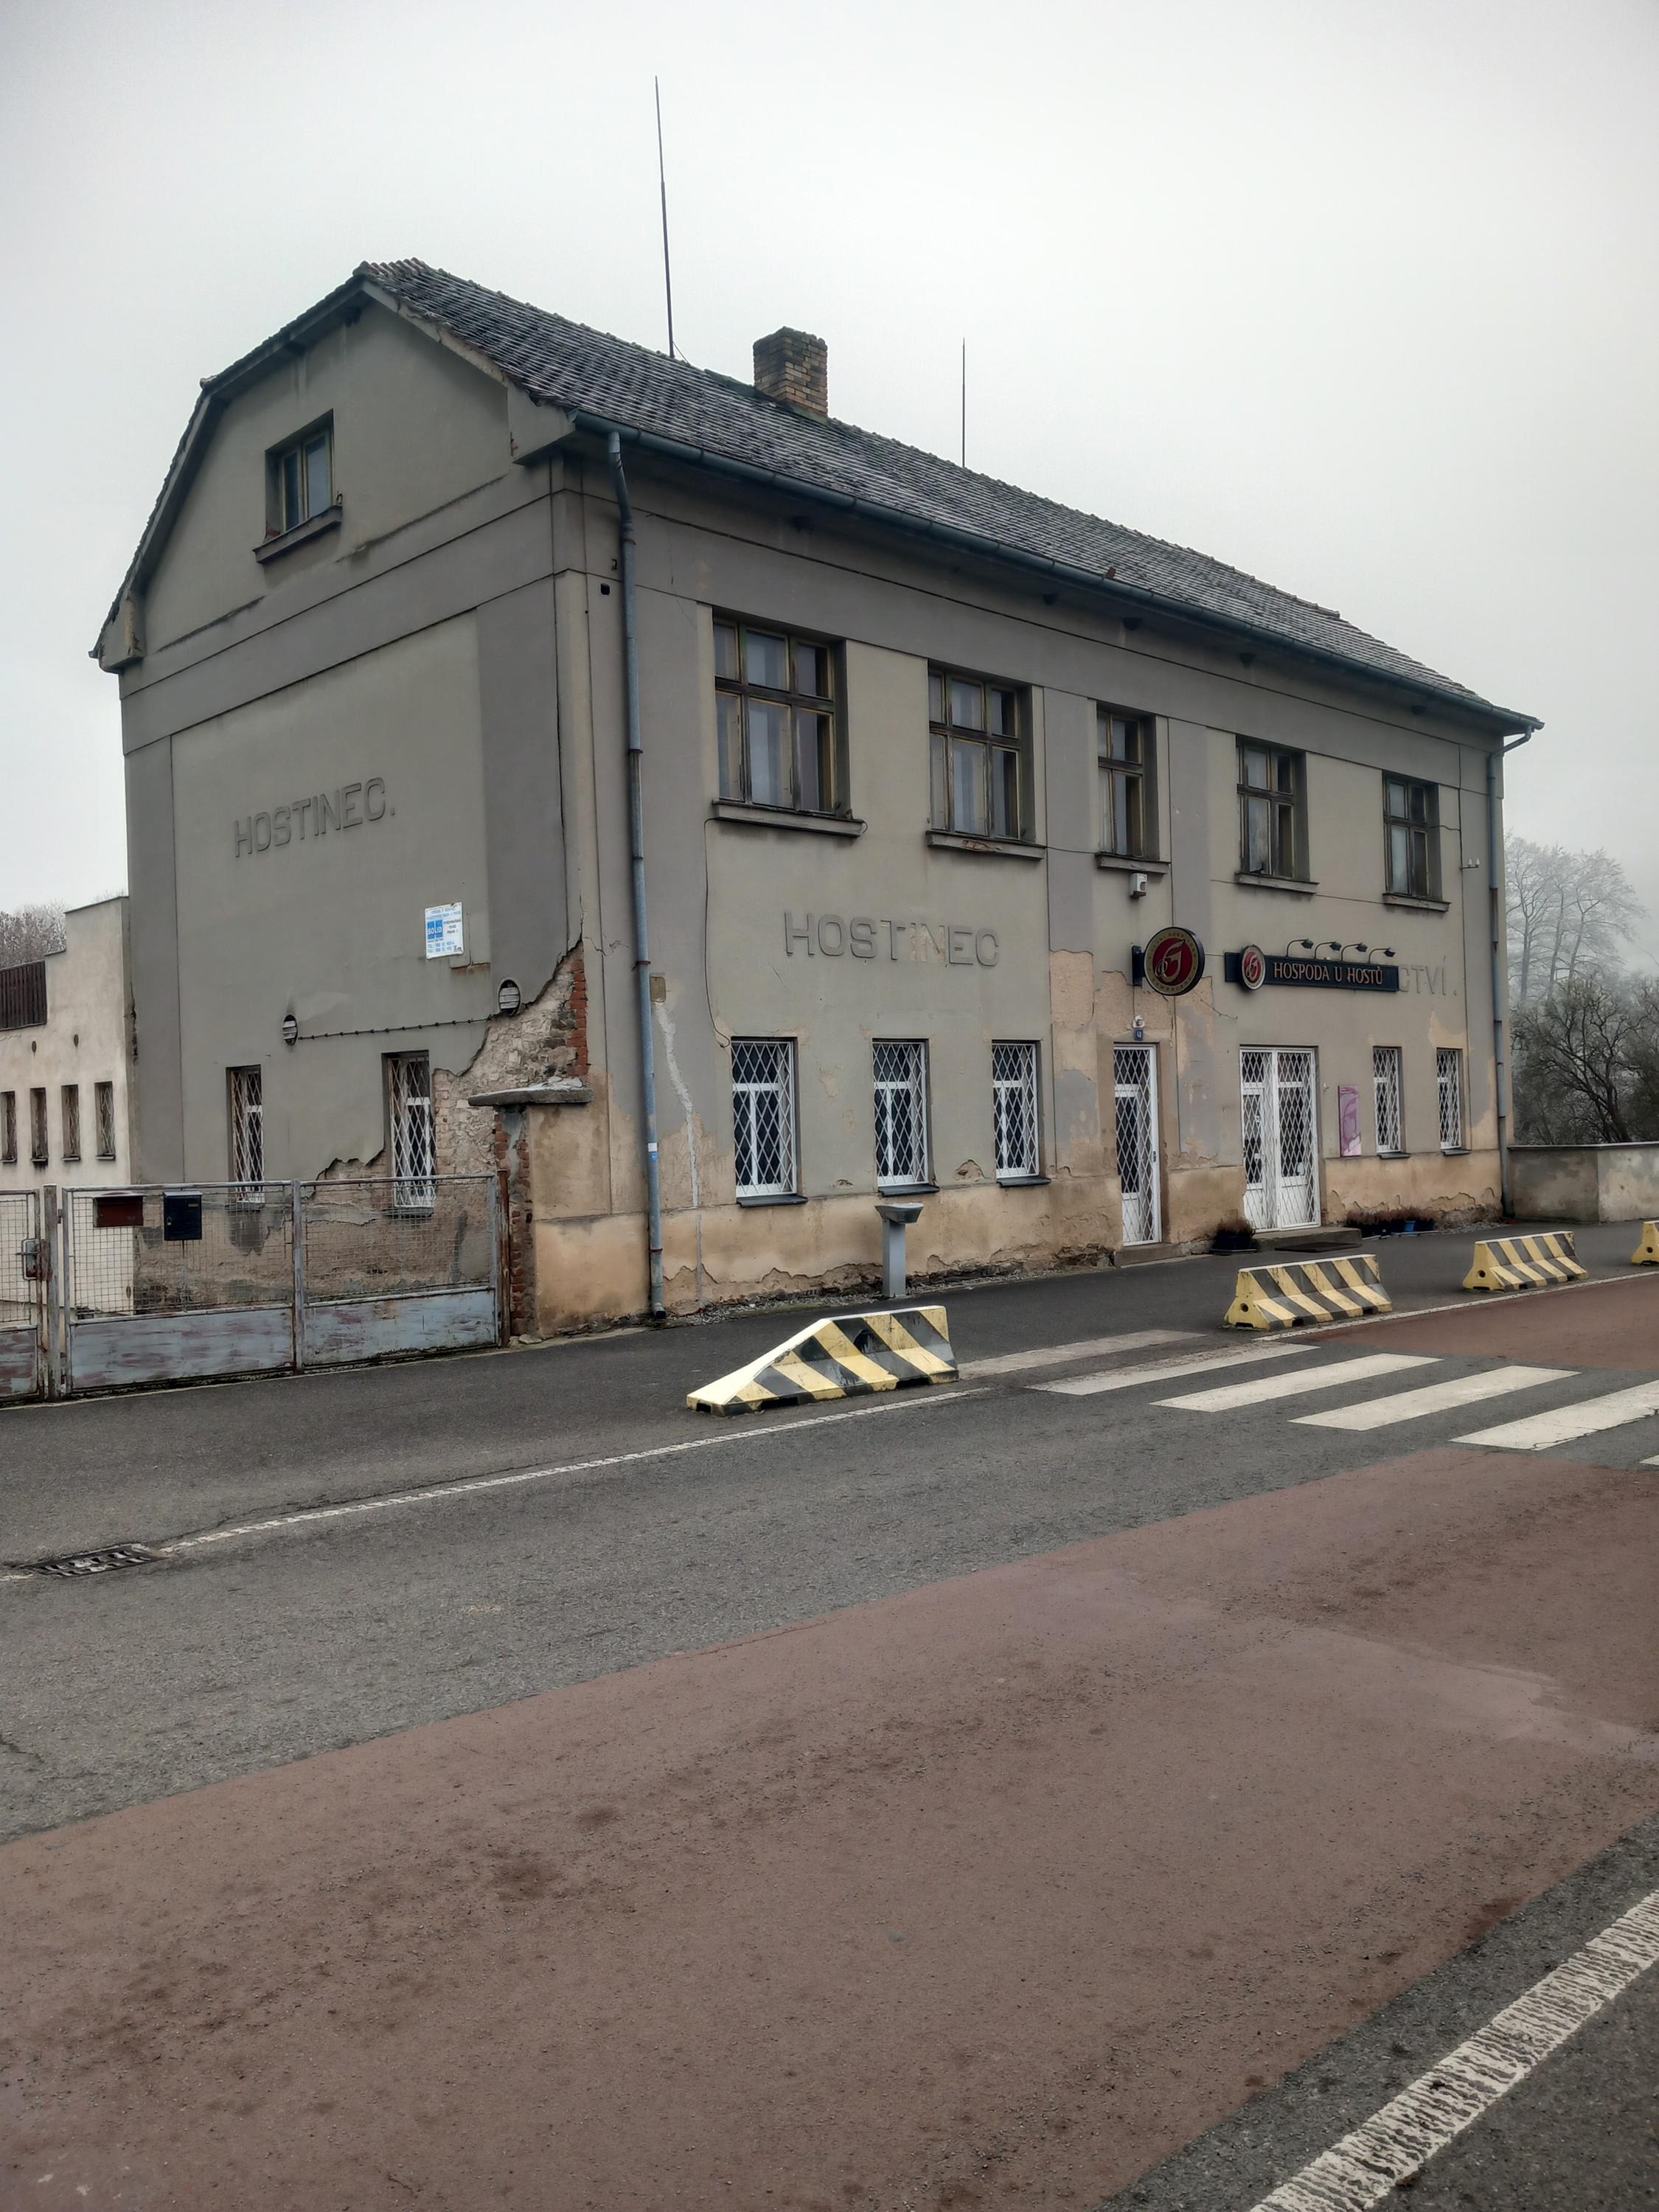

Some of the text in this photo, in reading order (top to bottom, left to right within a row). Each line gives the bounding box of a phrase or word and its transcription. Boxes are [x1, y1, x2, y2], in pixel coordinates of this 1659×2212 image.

[784, 912, 999, 967] HOSTINEC
[1274, 961, 1382, 985] HOSPODA U HOSTŮ
